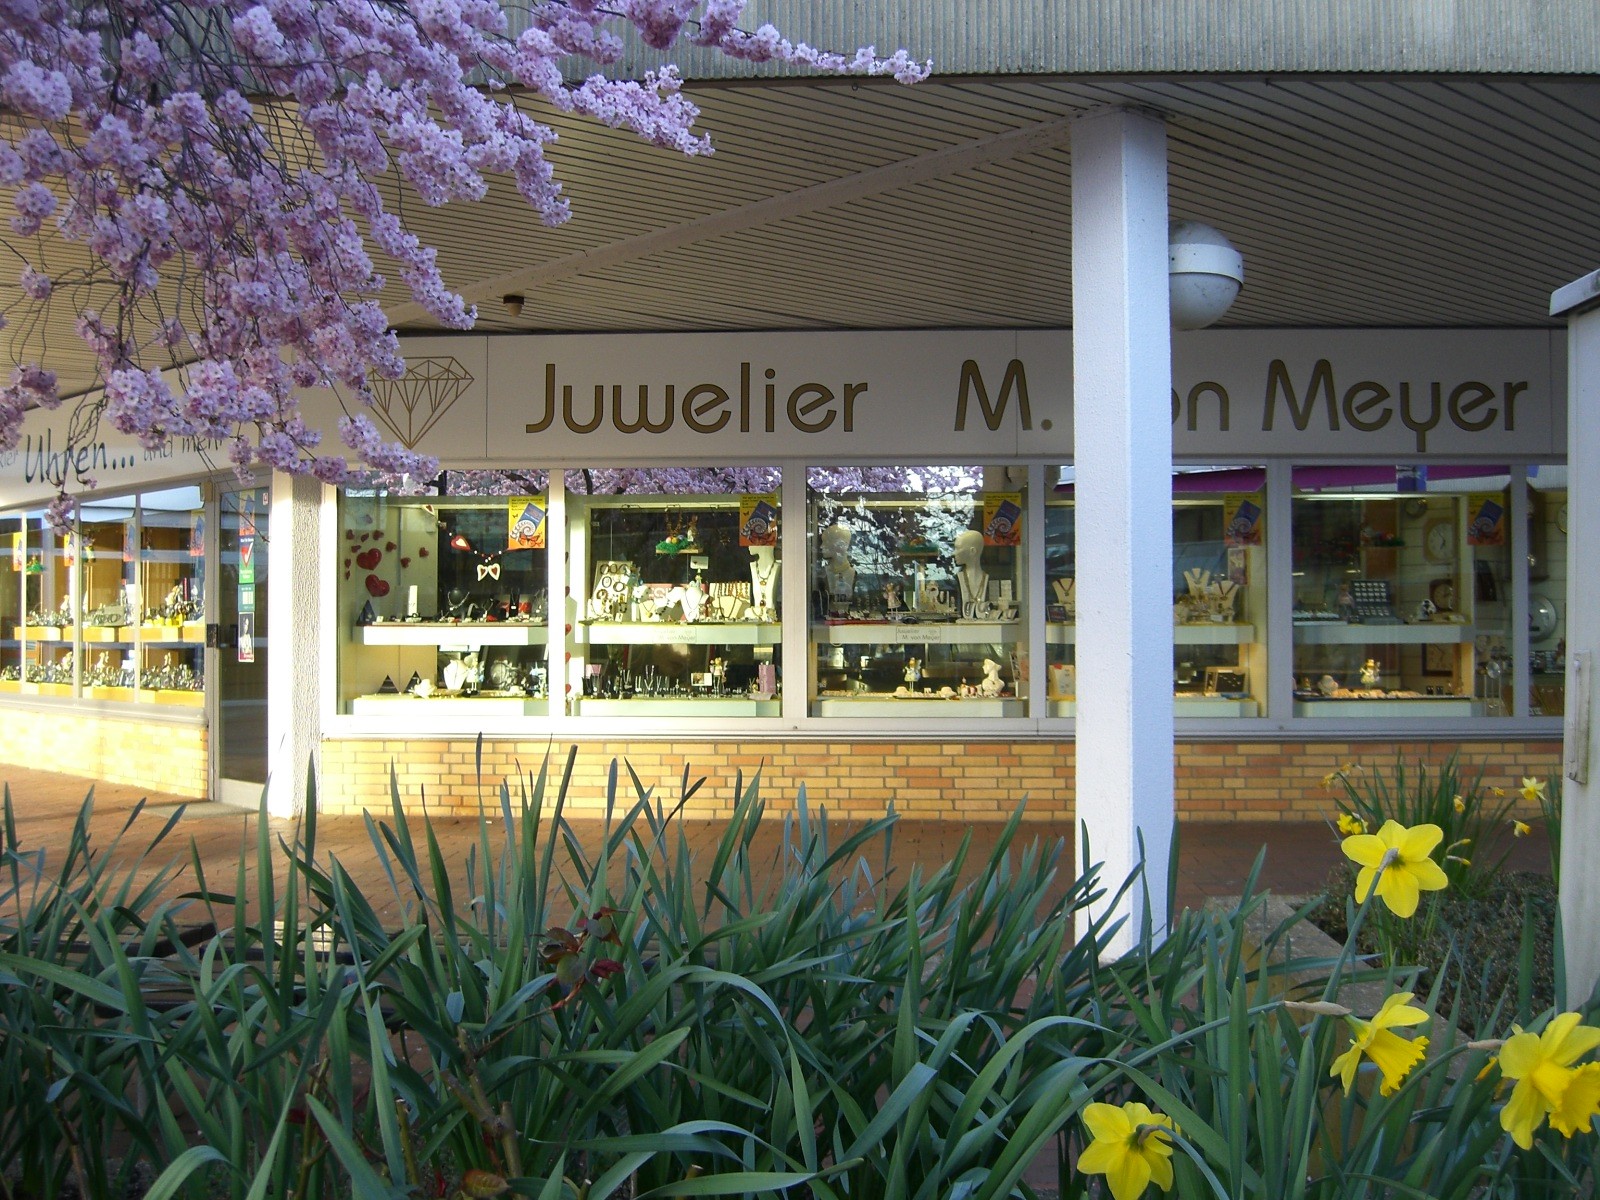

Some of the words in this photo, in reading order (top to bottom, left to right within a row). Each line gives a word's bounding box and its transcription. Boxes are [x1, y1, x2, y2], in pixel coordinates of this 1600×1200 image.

[526, 362, 868, 434] Juwelier
[954, 359, 1053, 431] M.
[1261, 359, 1528, 452] Meyer
